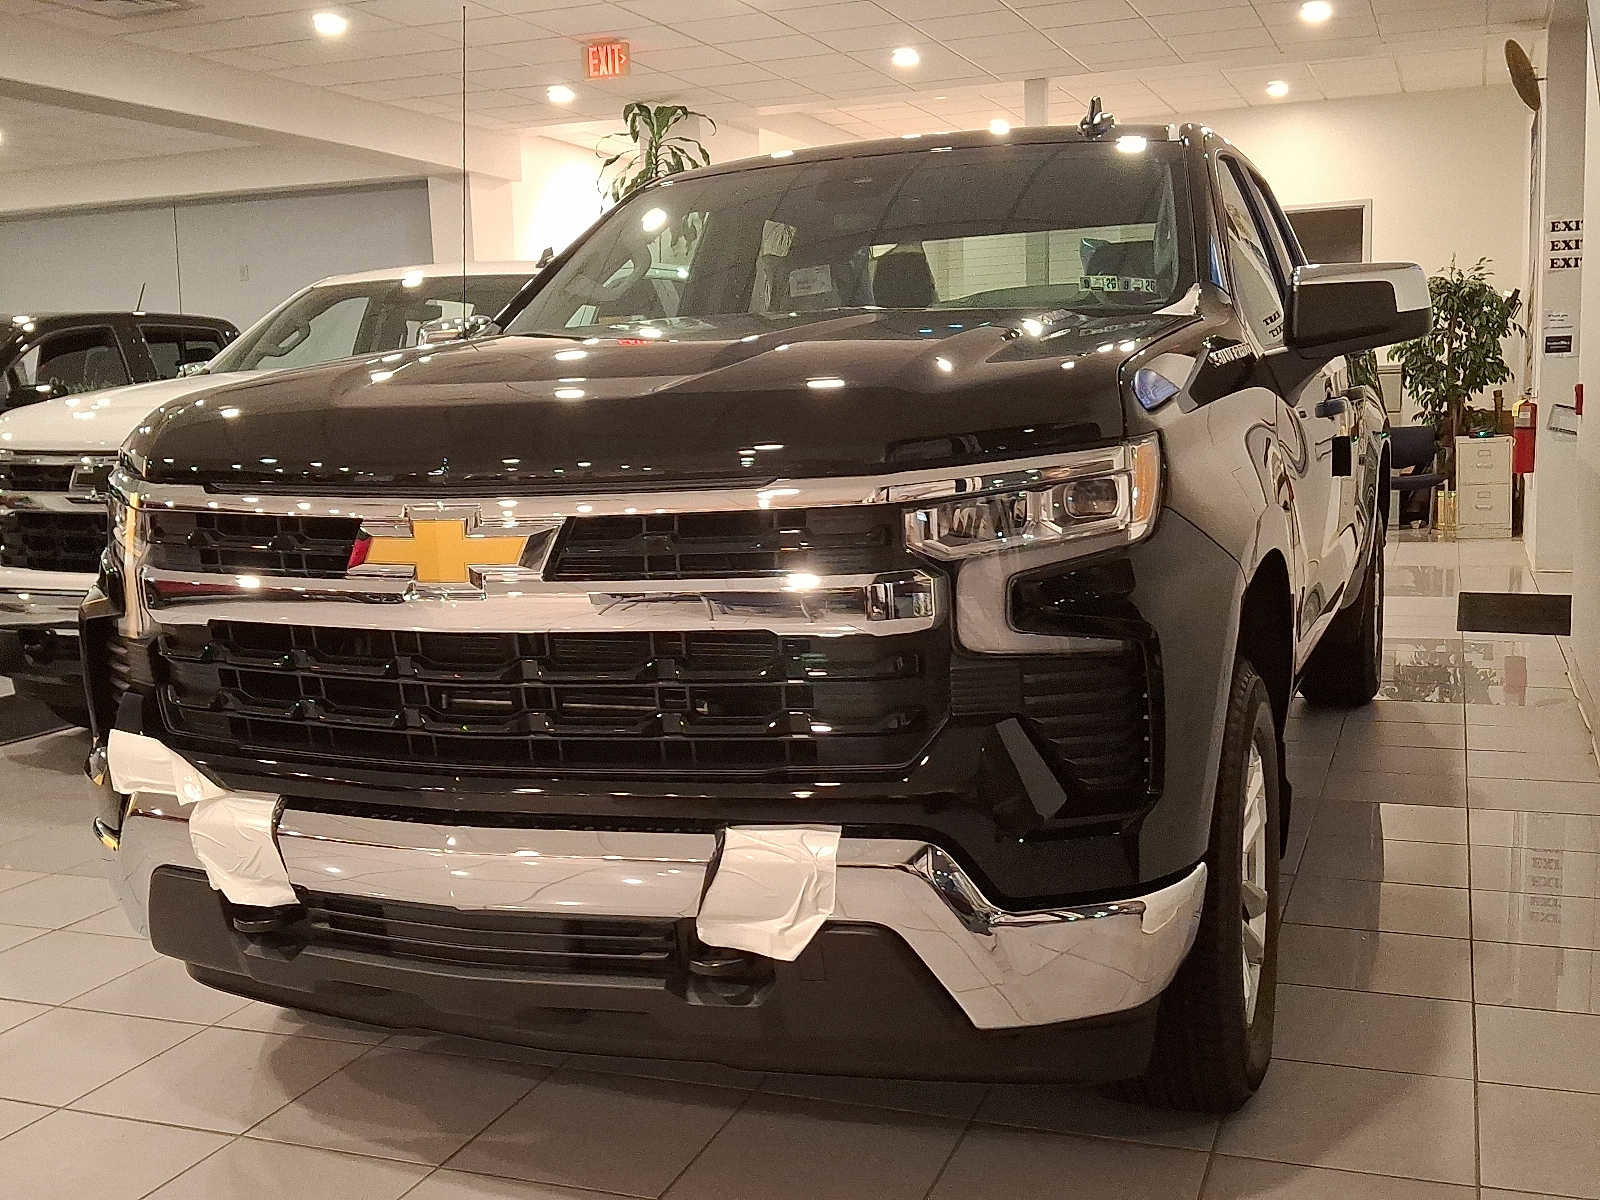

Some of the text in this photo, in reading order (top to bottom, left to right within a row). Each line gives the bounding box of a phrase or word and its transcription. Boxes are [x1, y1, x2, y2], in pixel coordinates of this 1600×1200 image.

[588, 46, 619, 77] EXIT
[1551, 220, 1583, 232] EXI
[1550, 239, 1583, 251] EXI
[1550, 257, 1582, 268] EXI
